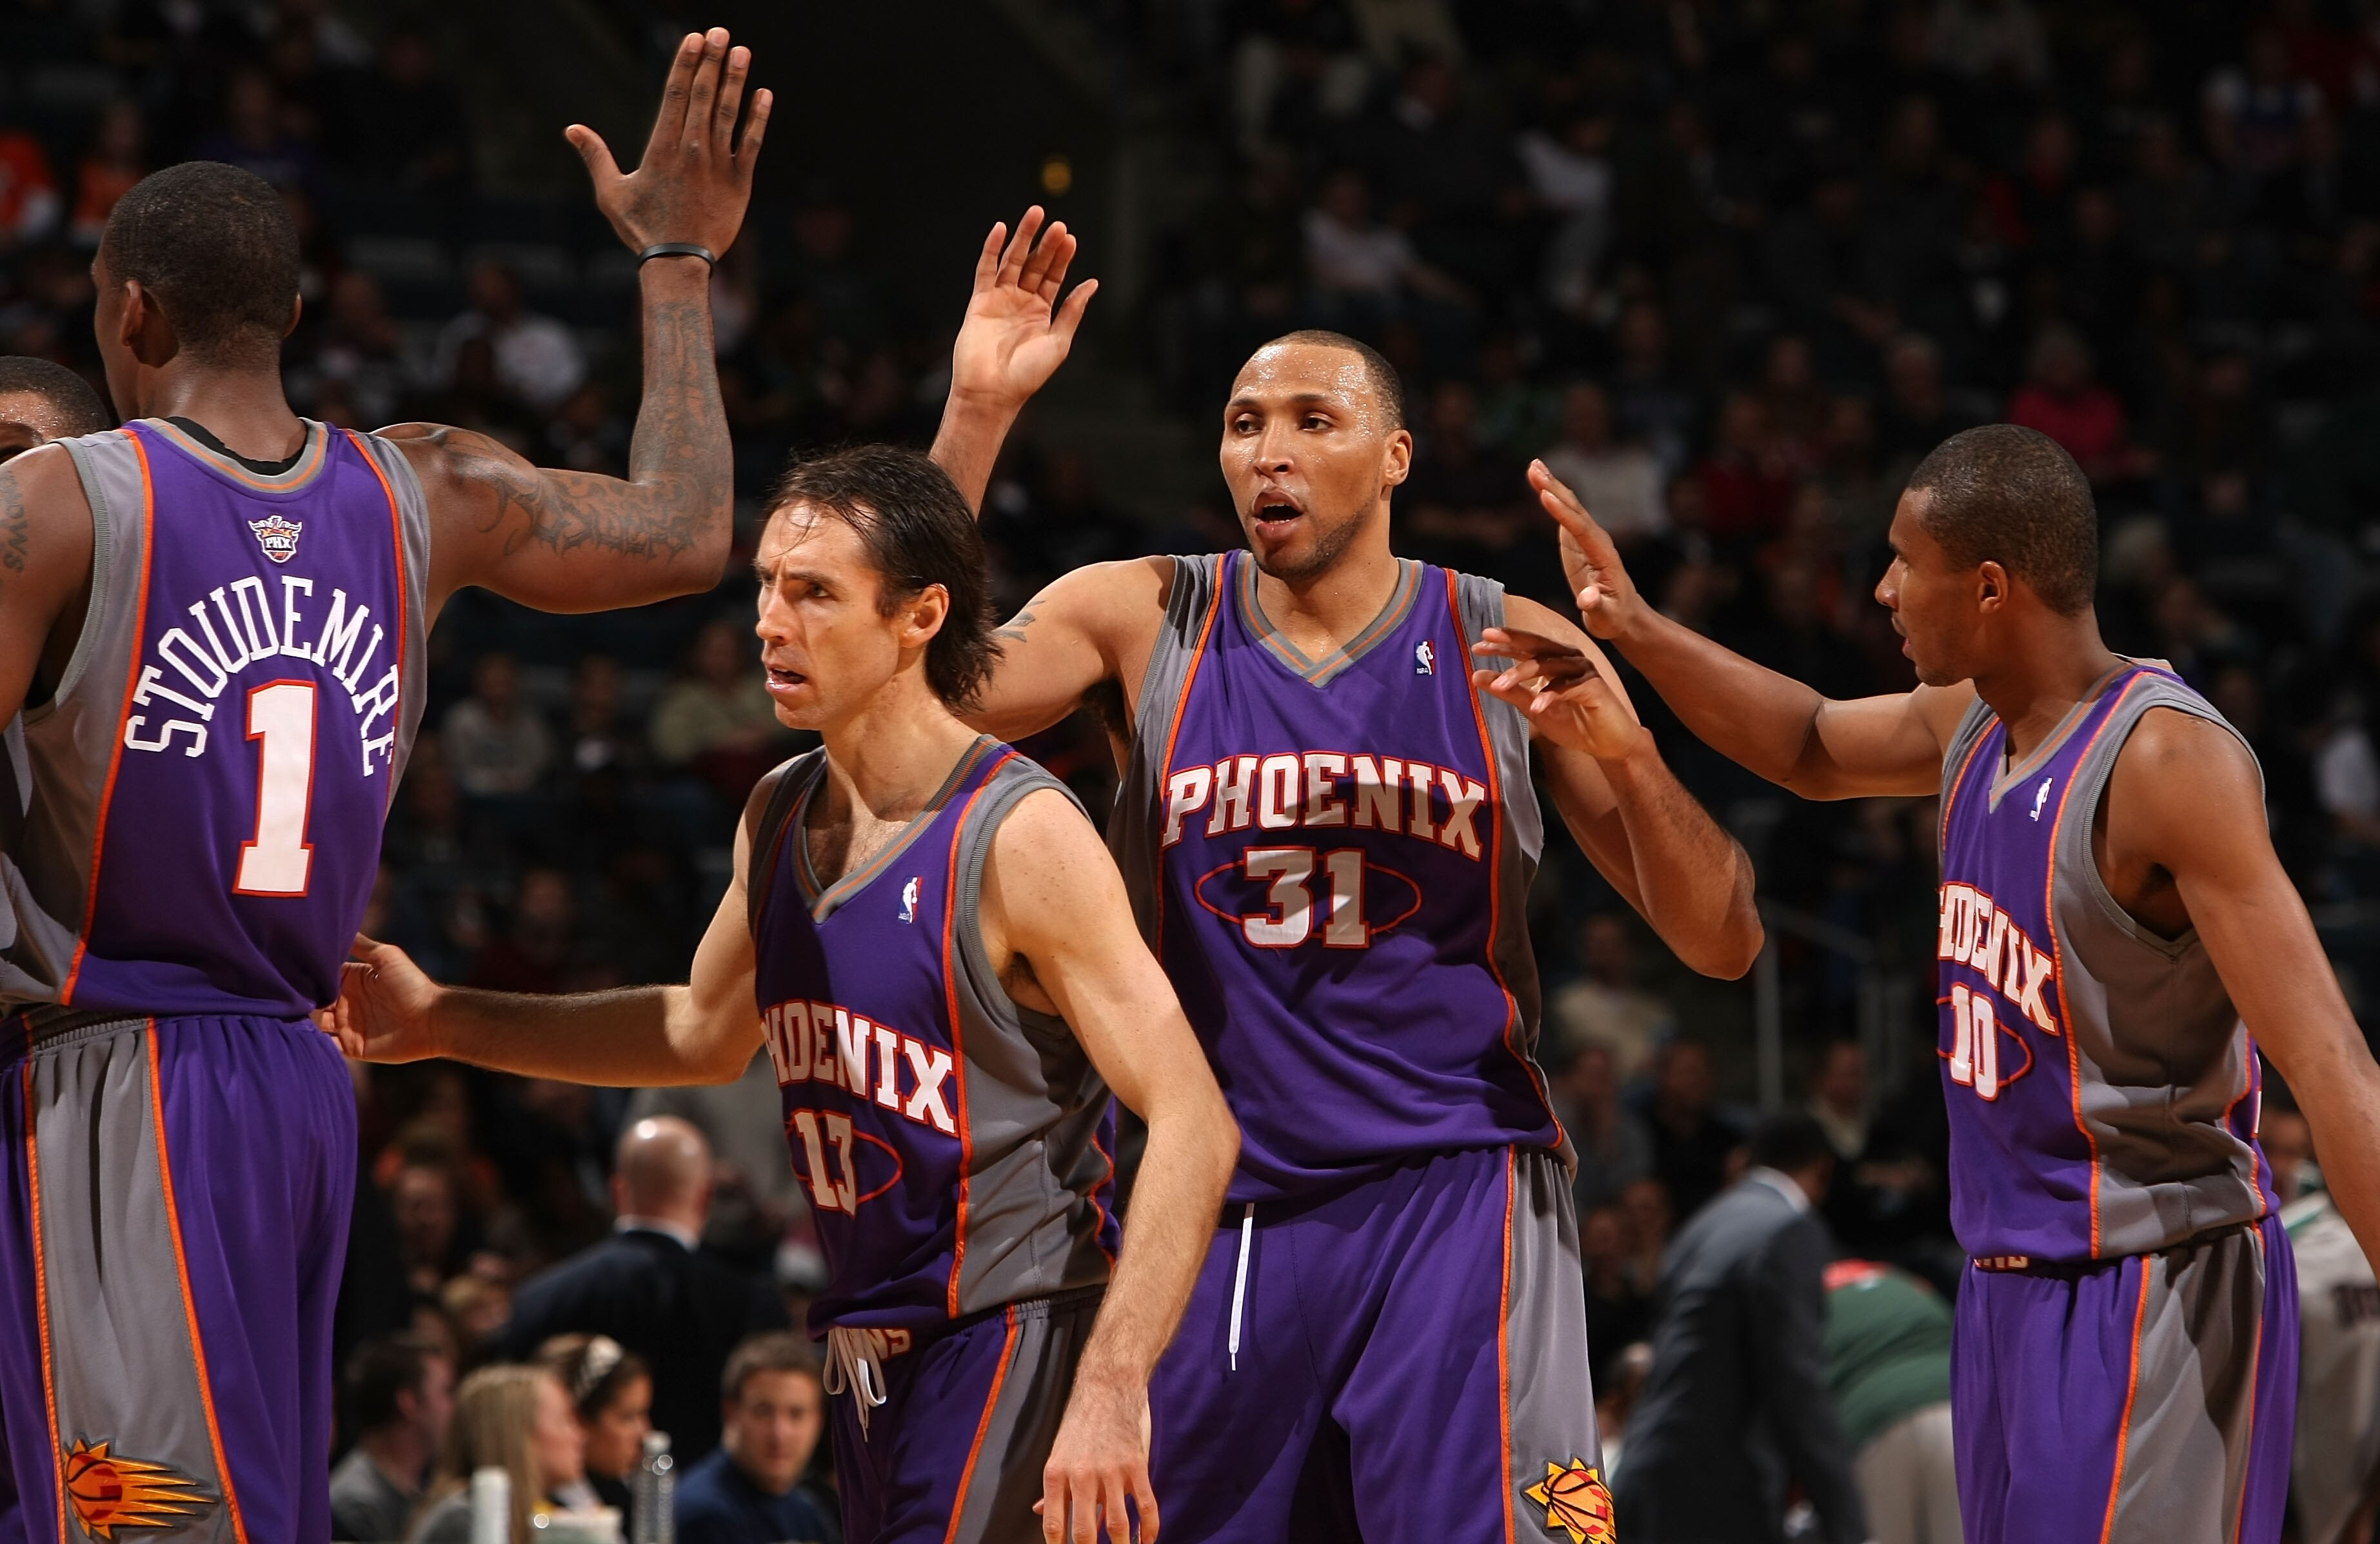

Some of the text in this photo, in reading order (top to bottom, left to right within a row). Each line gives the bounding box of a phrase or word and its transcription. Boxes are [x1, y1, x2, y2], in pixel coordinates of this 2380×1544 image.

[265, 536, 292, 549] PHX
[124, 575, 399, 777] STOUDEMIRE
[232, 678, 318, 897] 1
[1162, 751, 1487, 862] PHOENIX
[1241, 846, 1371, 948] 31
[1938, 881, 2060, 1037] HOENIX
[760, 997, 961, 1138] HOENIX
[1949, 981, 2000, 1102] 10
[791, 1107, 857, 1220] 13
